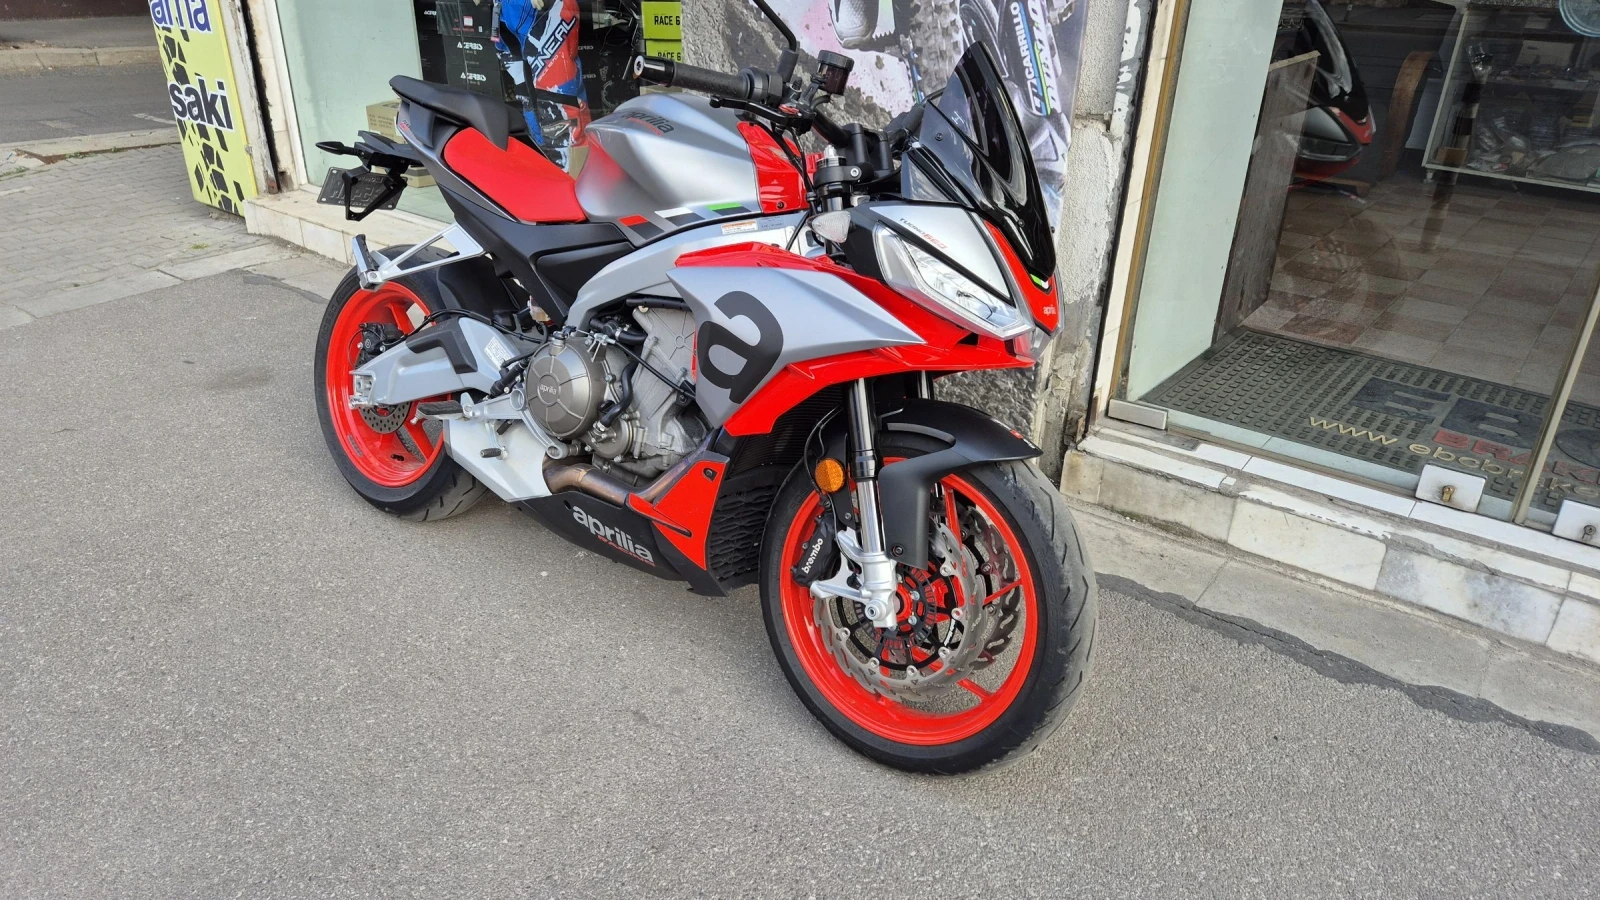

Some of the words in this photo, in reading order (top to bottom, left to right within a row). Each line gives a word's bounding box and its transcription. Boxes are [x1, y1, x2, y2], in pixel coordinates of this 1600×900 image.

[654, 15, 673, 26] RACE
[675, 15, 681, 26] 6
[1010, 1, 1034, 79] CARRILLO
[676, 51, 682, 61] 6
[169, 78, 234, 130] saki
[696, 290, 784, 404] a
[539, 383, 558, 395] aprilia
[572, 505, 654, 563] aprilia
[801, 538, 824, 574] brembo
